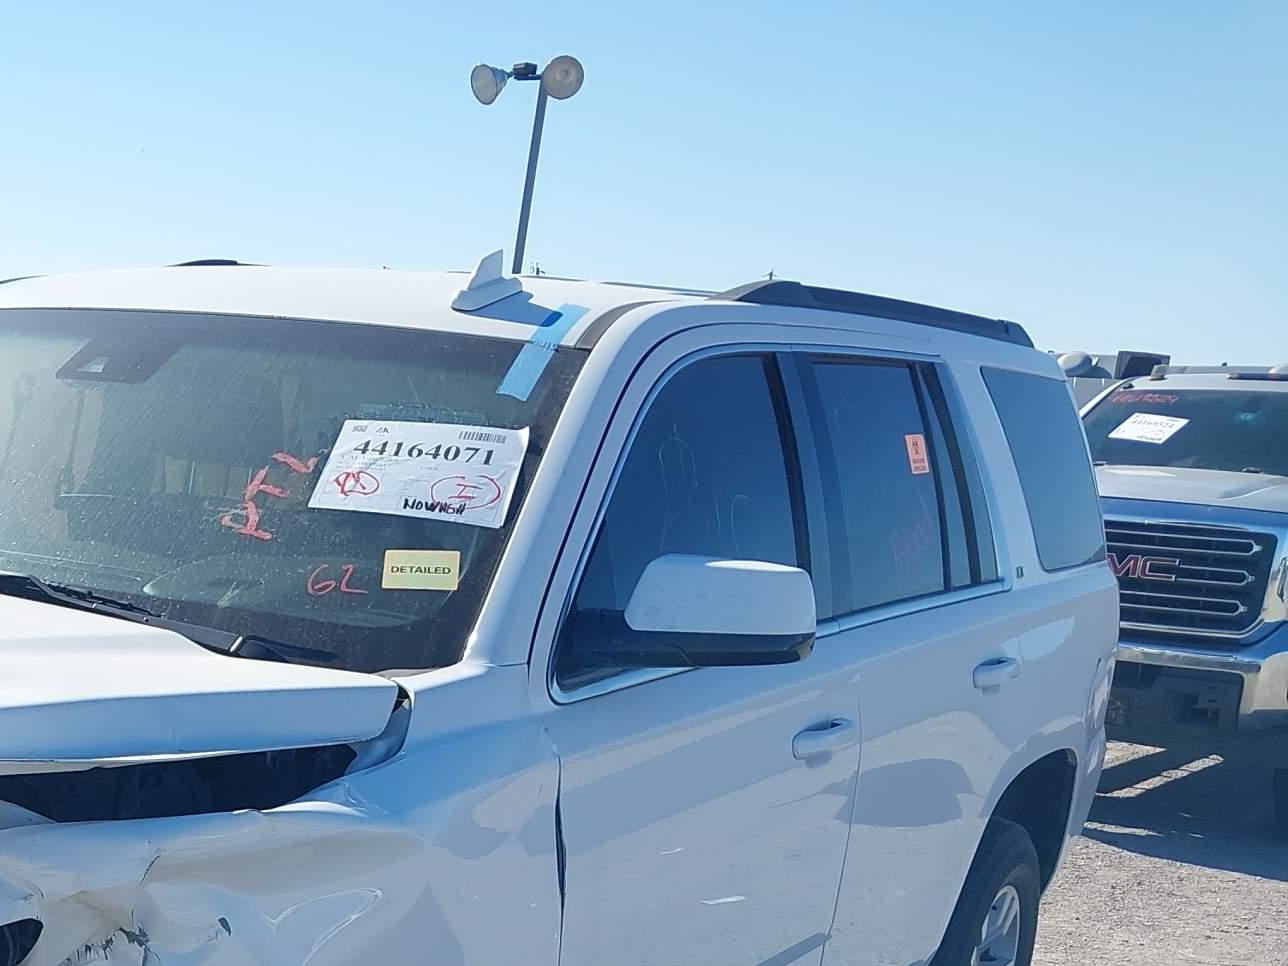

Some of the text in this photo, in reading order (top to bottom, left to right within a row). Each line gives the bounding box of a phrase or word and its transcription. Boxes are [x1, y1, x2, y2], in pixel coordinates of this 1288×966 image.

[353, 440, 496, 466] 44164071
[390, 564, 452, 576] DETAILED
[1106, 552, 1180, 581] MC
